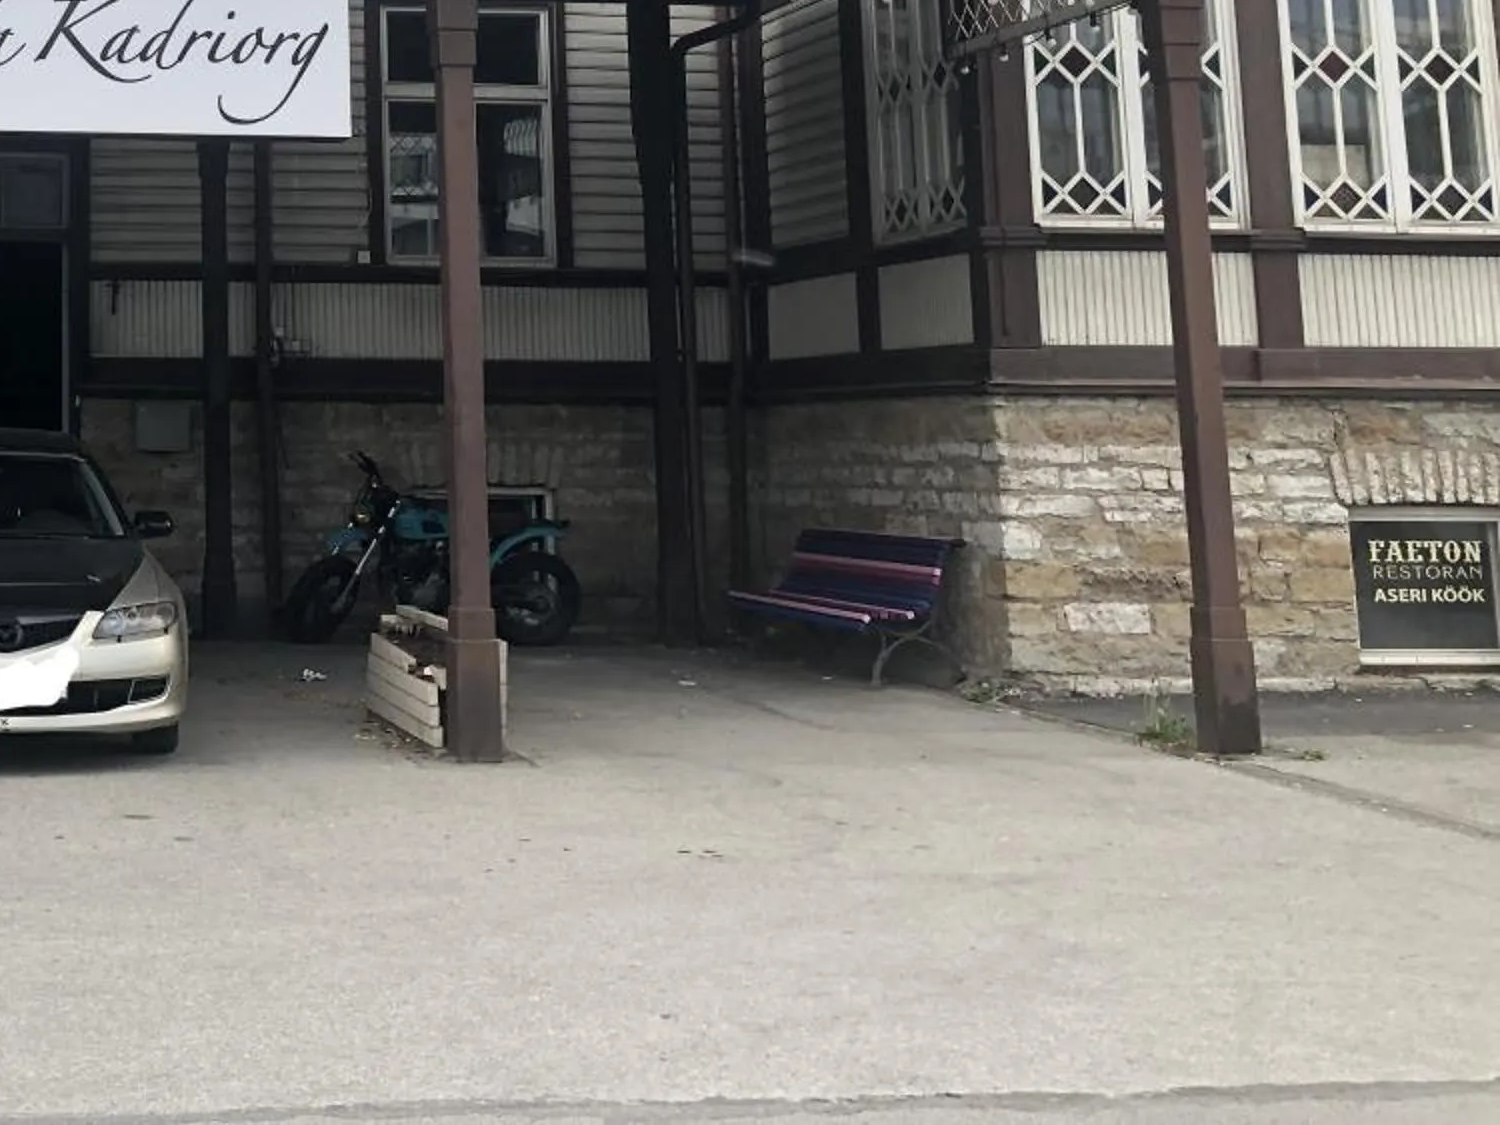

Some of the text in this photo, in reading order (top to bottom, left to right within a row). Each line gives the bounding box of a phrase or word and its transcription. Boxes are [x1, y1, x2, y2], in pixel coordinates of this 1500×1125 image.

[1368, 540, 1482, 563] FAETON
[1373, 565, 1483, 580] RESTORAN
[1374, 585, 1485, 603] ASERI KÖÖK
